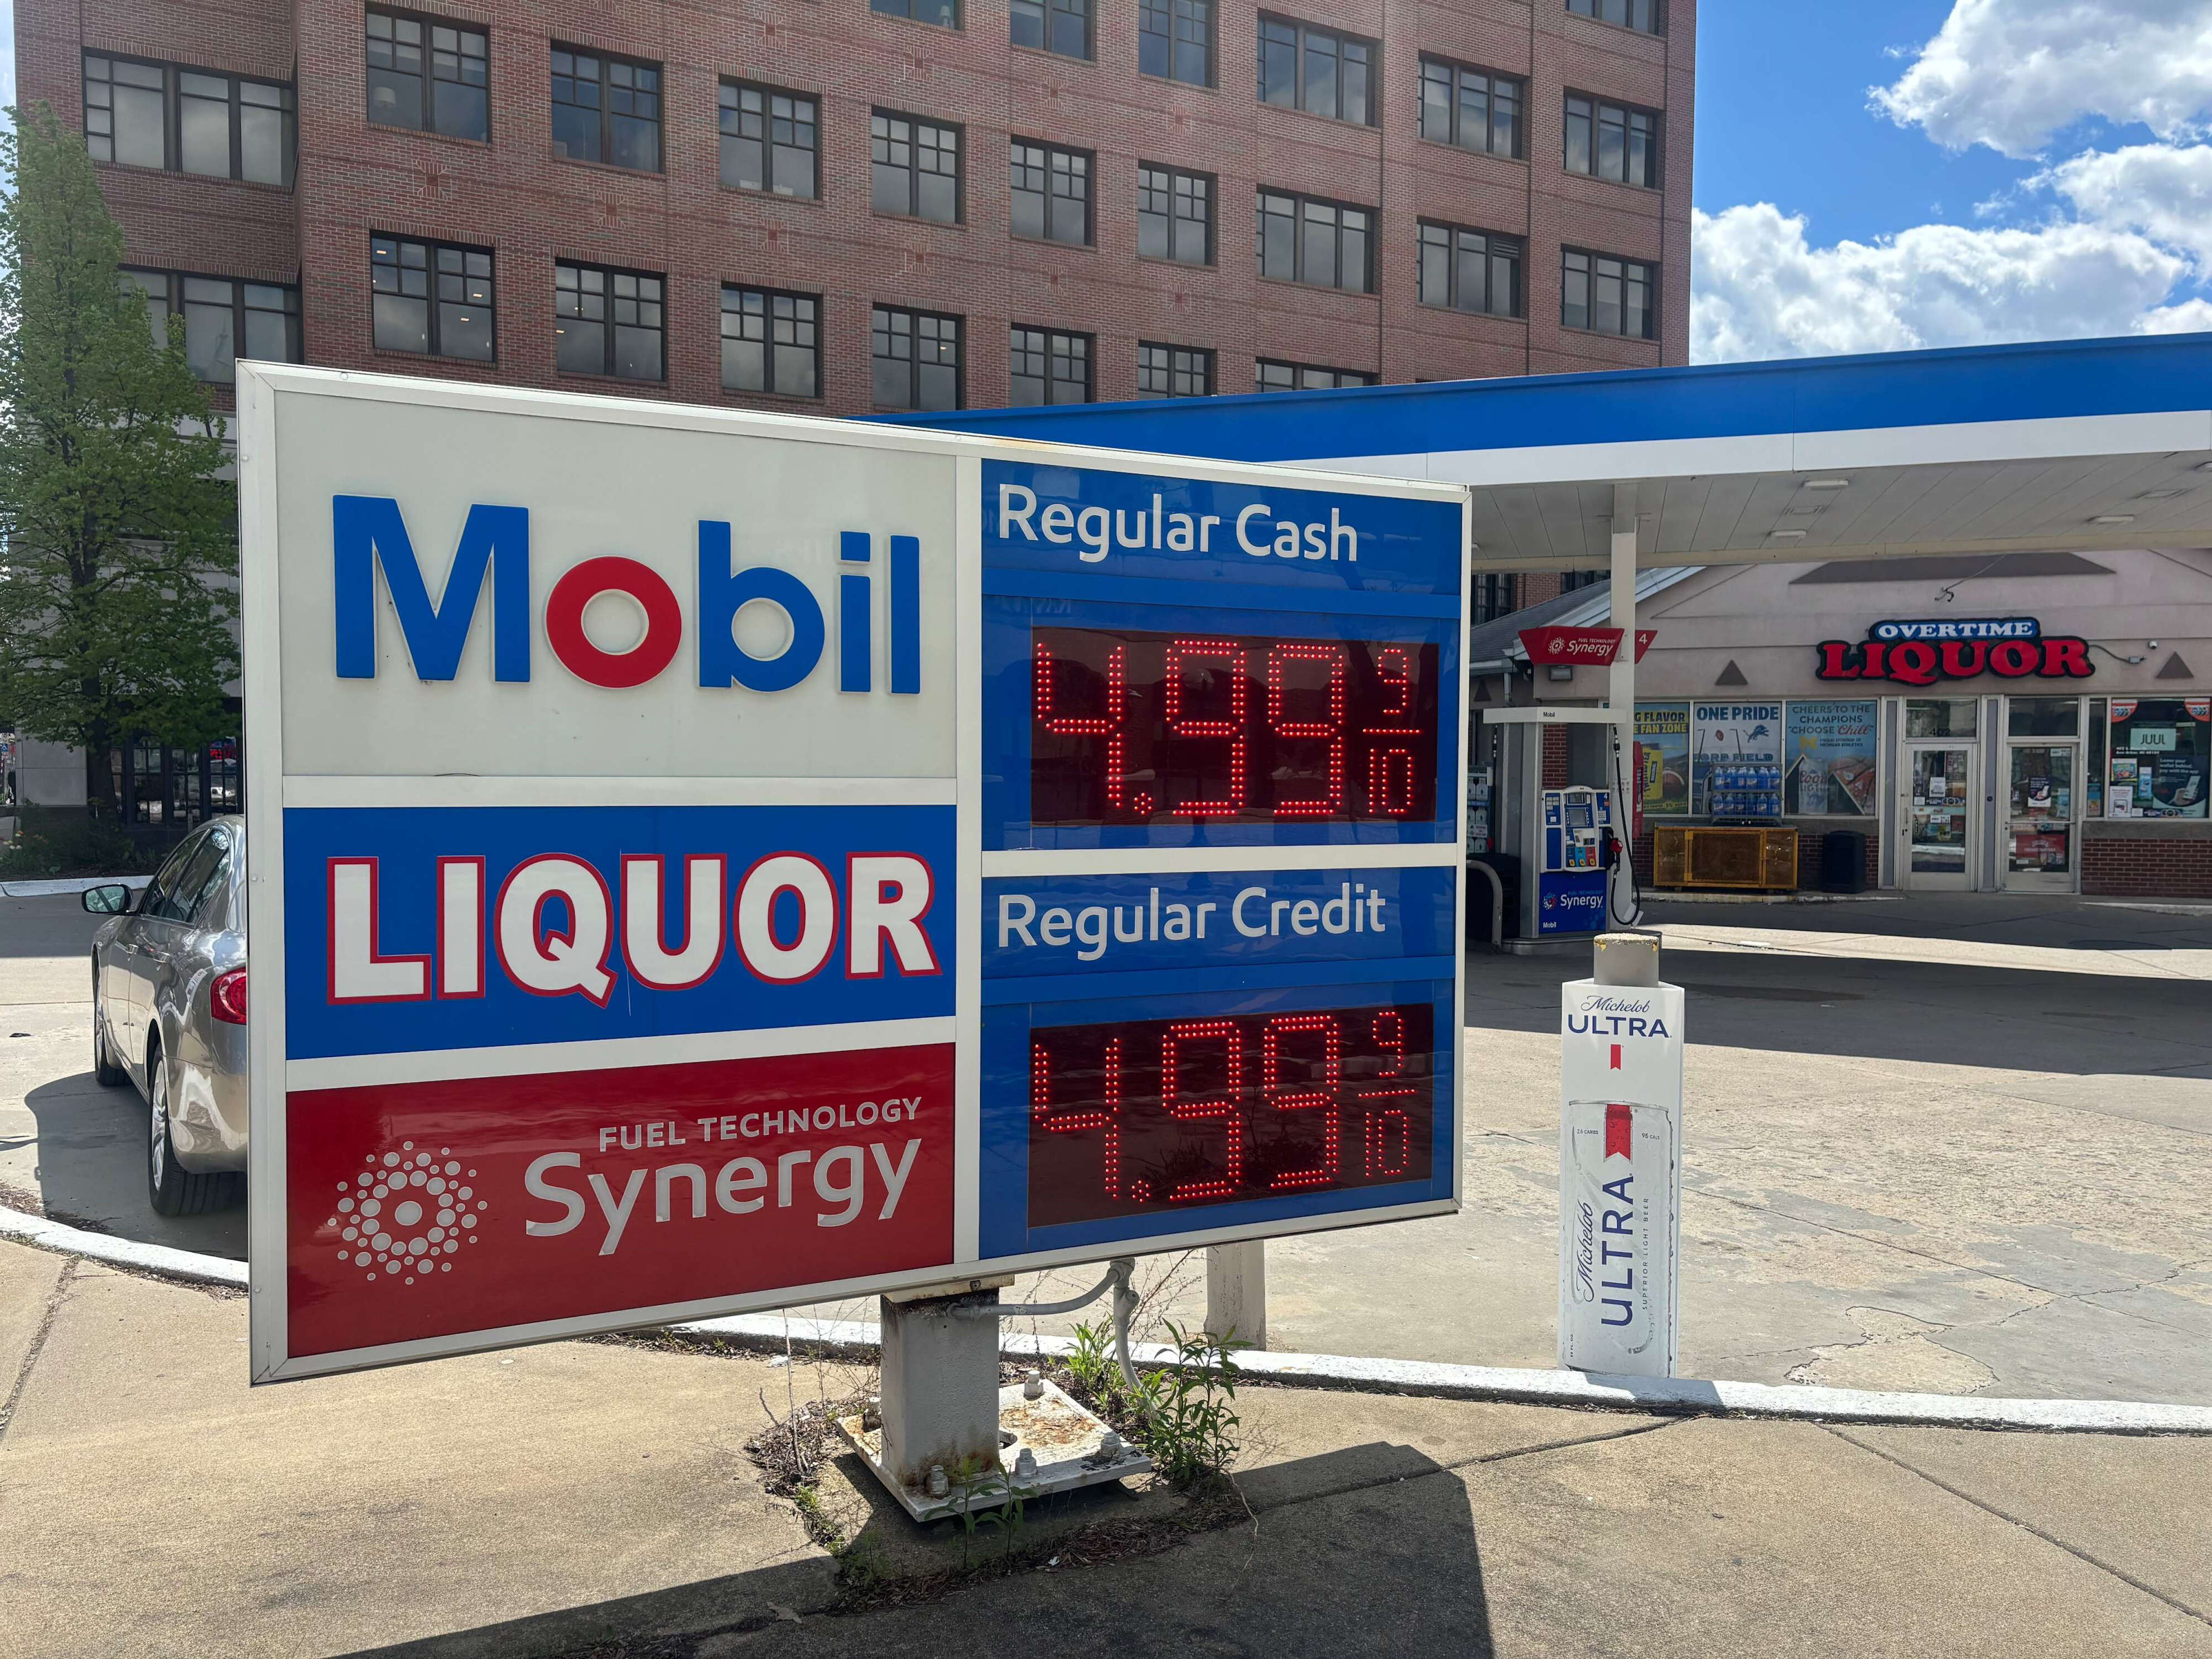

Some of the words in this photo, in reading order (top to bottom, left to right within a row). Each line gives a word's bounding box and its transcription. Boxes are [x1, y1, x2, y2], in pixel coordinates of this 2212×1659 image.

[999, 483, 1220, 563] Regular
[1236, 504, 1358, 562] Cash
[332, 493, 921, 694] Mobil
[1638, 633, 1647, 644] 4
[1878, 621, 2034, 638] OVERTIME
[1567, 640, 1613, 656] Synergy
[1821, 639, 2093, 685] LIQUOR
[1644, 711, 1685, 722] FLAVOR
[1697, 707, 1728, 721] ONE
[1732, 706, 1779, 720] PRIDE
[1792, 705, 1832, 713] CHEERS
[1835, 705, 1848, 713] TO
[1850, 705, 1870, 713] THE
[1641, 724, 1660, 734] FAN
[1662, 723, 1687, 733] ZONE
[1800, 715, 1862, 724] CHAMPIONS
[2140, 734, 2166, 745] JUUL
[1560, 894, 1603, 910] Synergy
[327, 851, 942, 1009] LIQUOR
[999, 887, 1216, 961] Regular
[1232, 882, 1386, 938] Credit
[1580, 995, 1651, 1013] Michelob
[1568, 1014, 1670, 1038] ULTRA
[599, 1122, 686, 1152] FUEL
[698, 1096, 922, 1144] TECHNOLOGY
[524, 1137, 922, 1256] Synergy
[1577, 1198, 1594, 1303] Michelob
[1601, 1176, 1633, 1326] ULTRA
